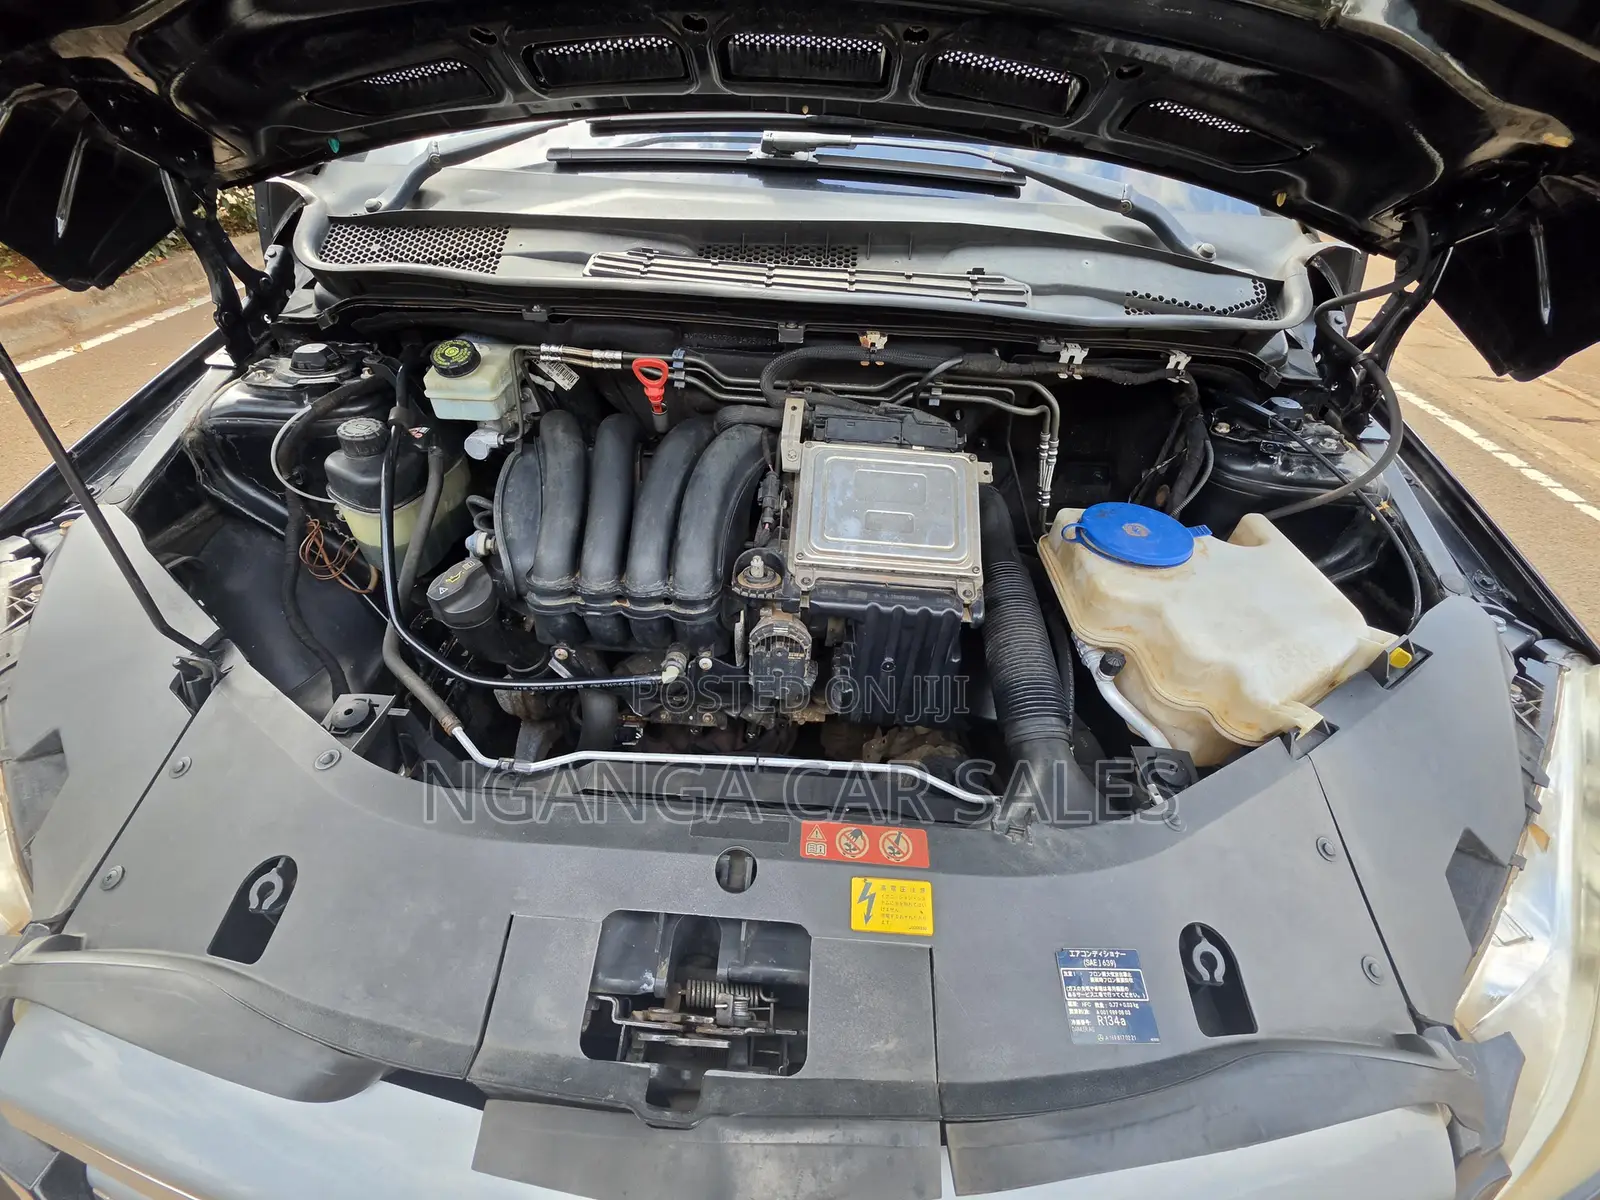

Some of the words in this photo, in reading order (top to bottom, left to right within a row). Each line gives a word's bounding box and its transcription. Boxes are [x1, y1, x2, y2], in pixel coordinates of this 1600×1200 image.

[1069, 950, 1127, 958] エアコンディショナー
[1096, 1015, 1127, 1026] R134a
